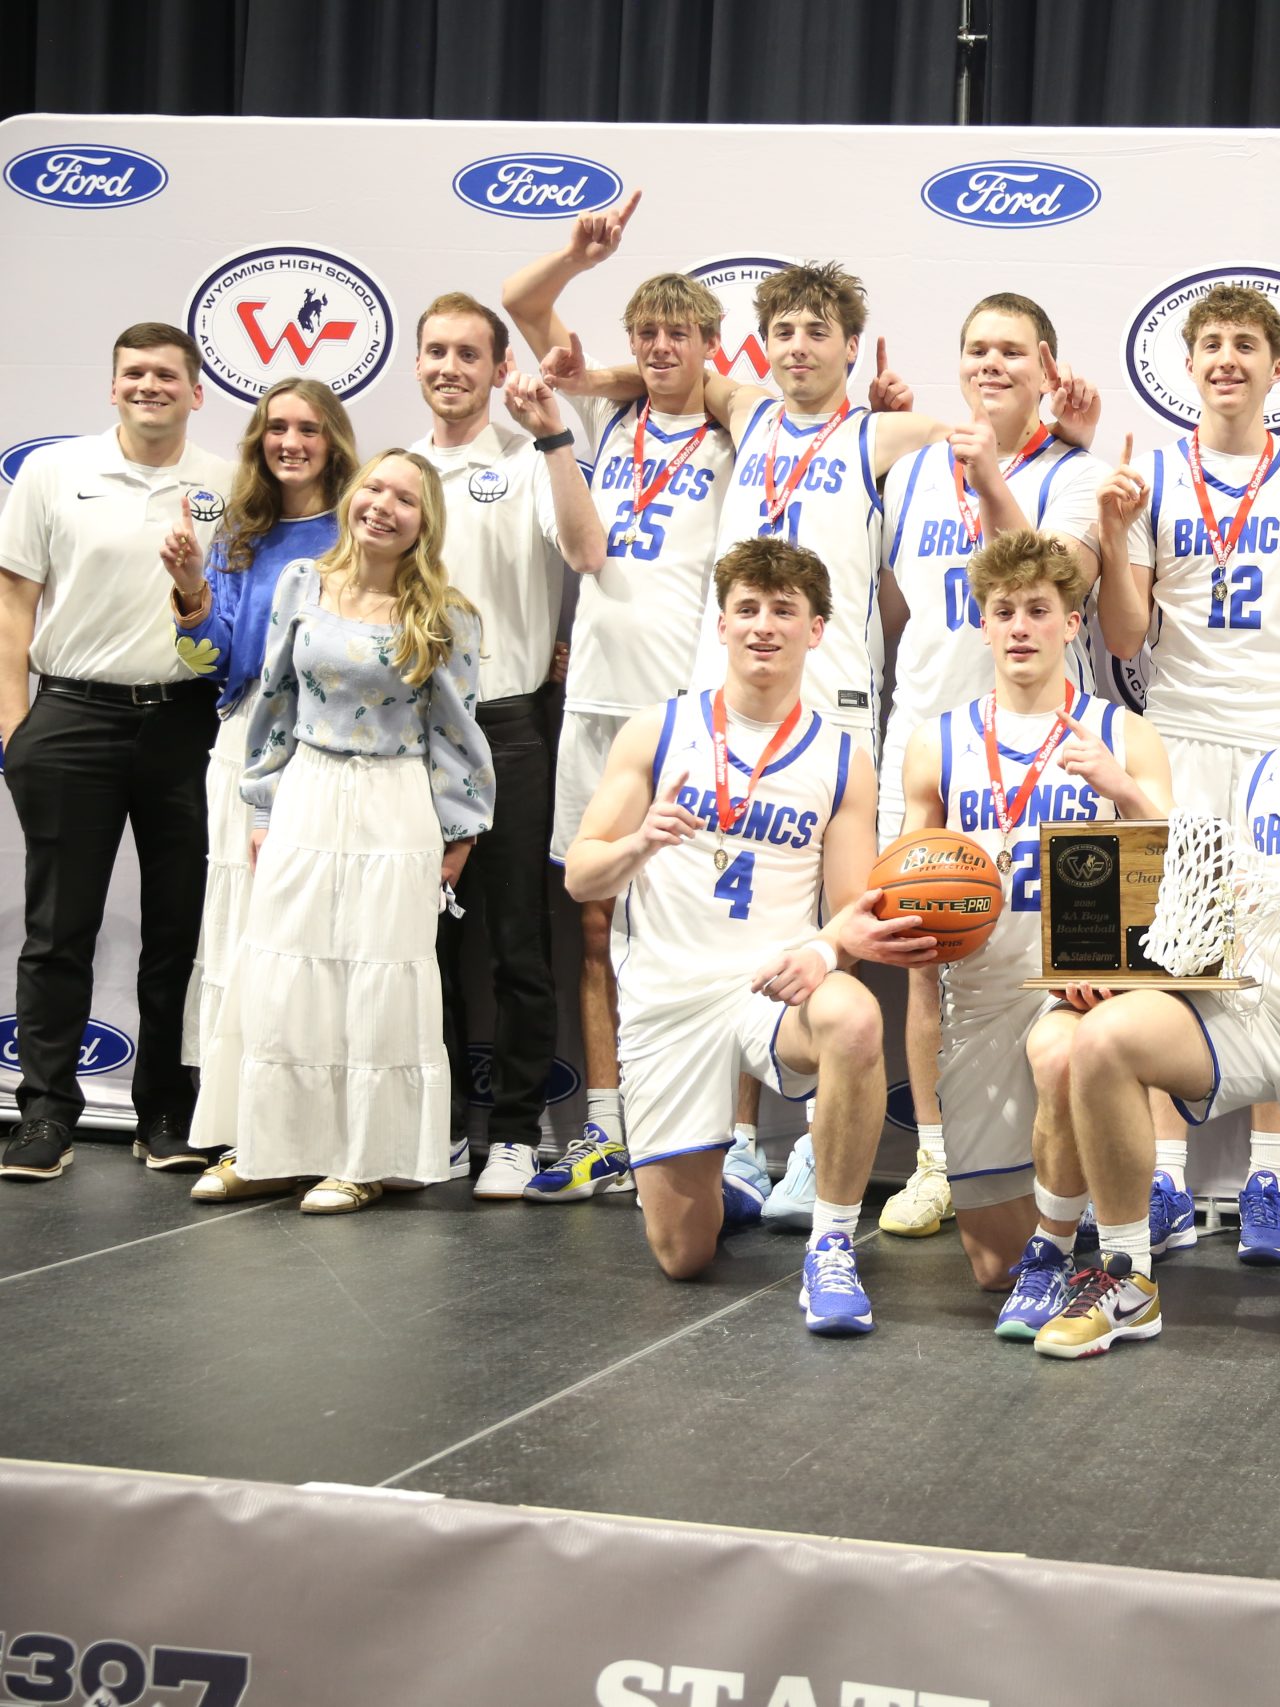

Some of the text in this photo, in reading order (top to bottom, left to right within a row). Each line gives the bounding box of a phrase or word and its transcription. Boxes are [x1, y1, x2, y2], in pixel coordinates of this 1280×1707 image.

[36, 153, 136, 198] Ford
[486, 162, 589, 207] Ford
[956, 170, 1066, 216] Ford
[202, 258, 376, 317] WYOMING HIGH SCHOOL
[199, 333, 269, 395] ACTIVITIE
[331, 339, 381, 392] CIATION
[1139, 359, 1202, 420] ACTIVITI
[606, 500, 674, 562] 25
[1207, 565, 1264, 630] 12
[713, 850, 756, 921] 4
[901, 846, 987, 873] Baden
[898, 898, 991, 912] ELITE PRO
[1056, 923, 1116, 934] Basketball
